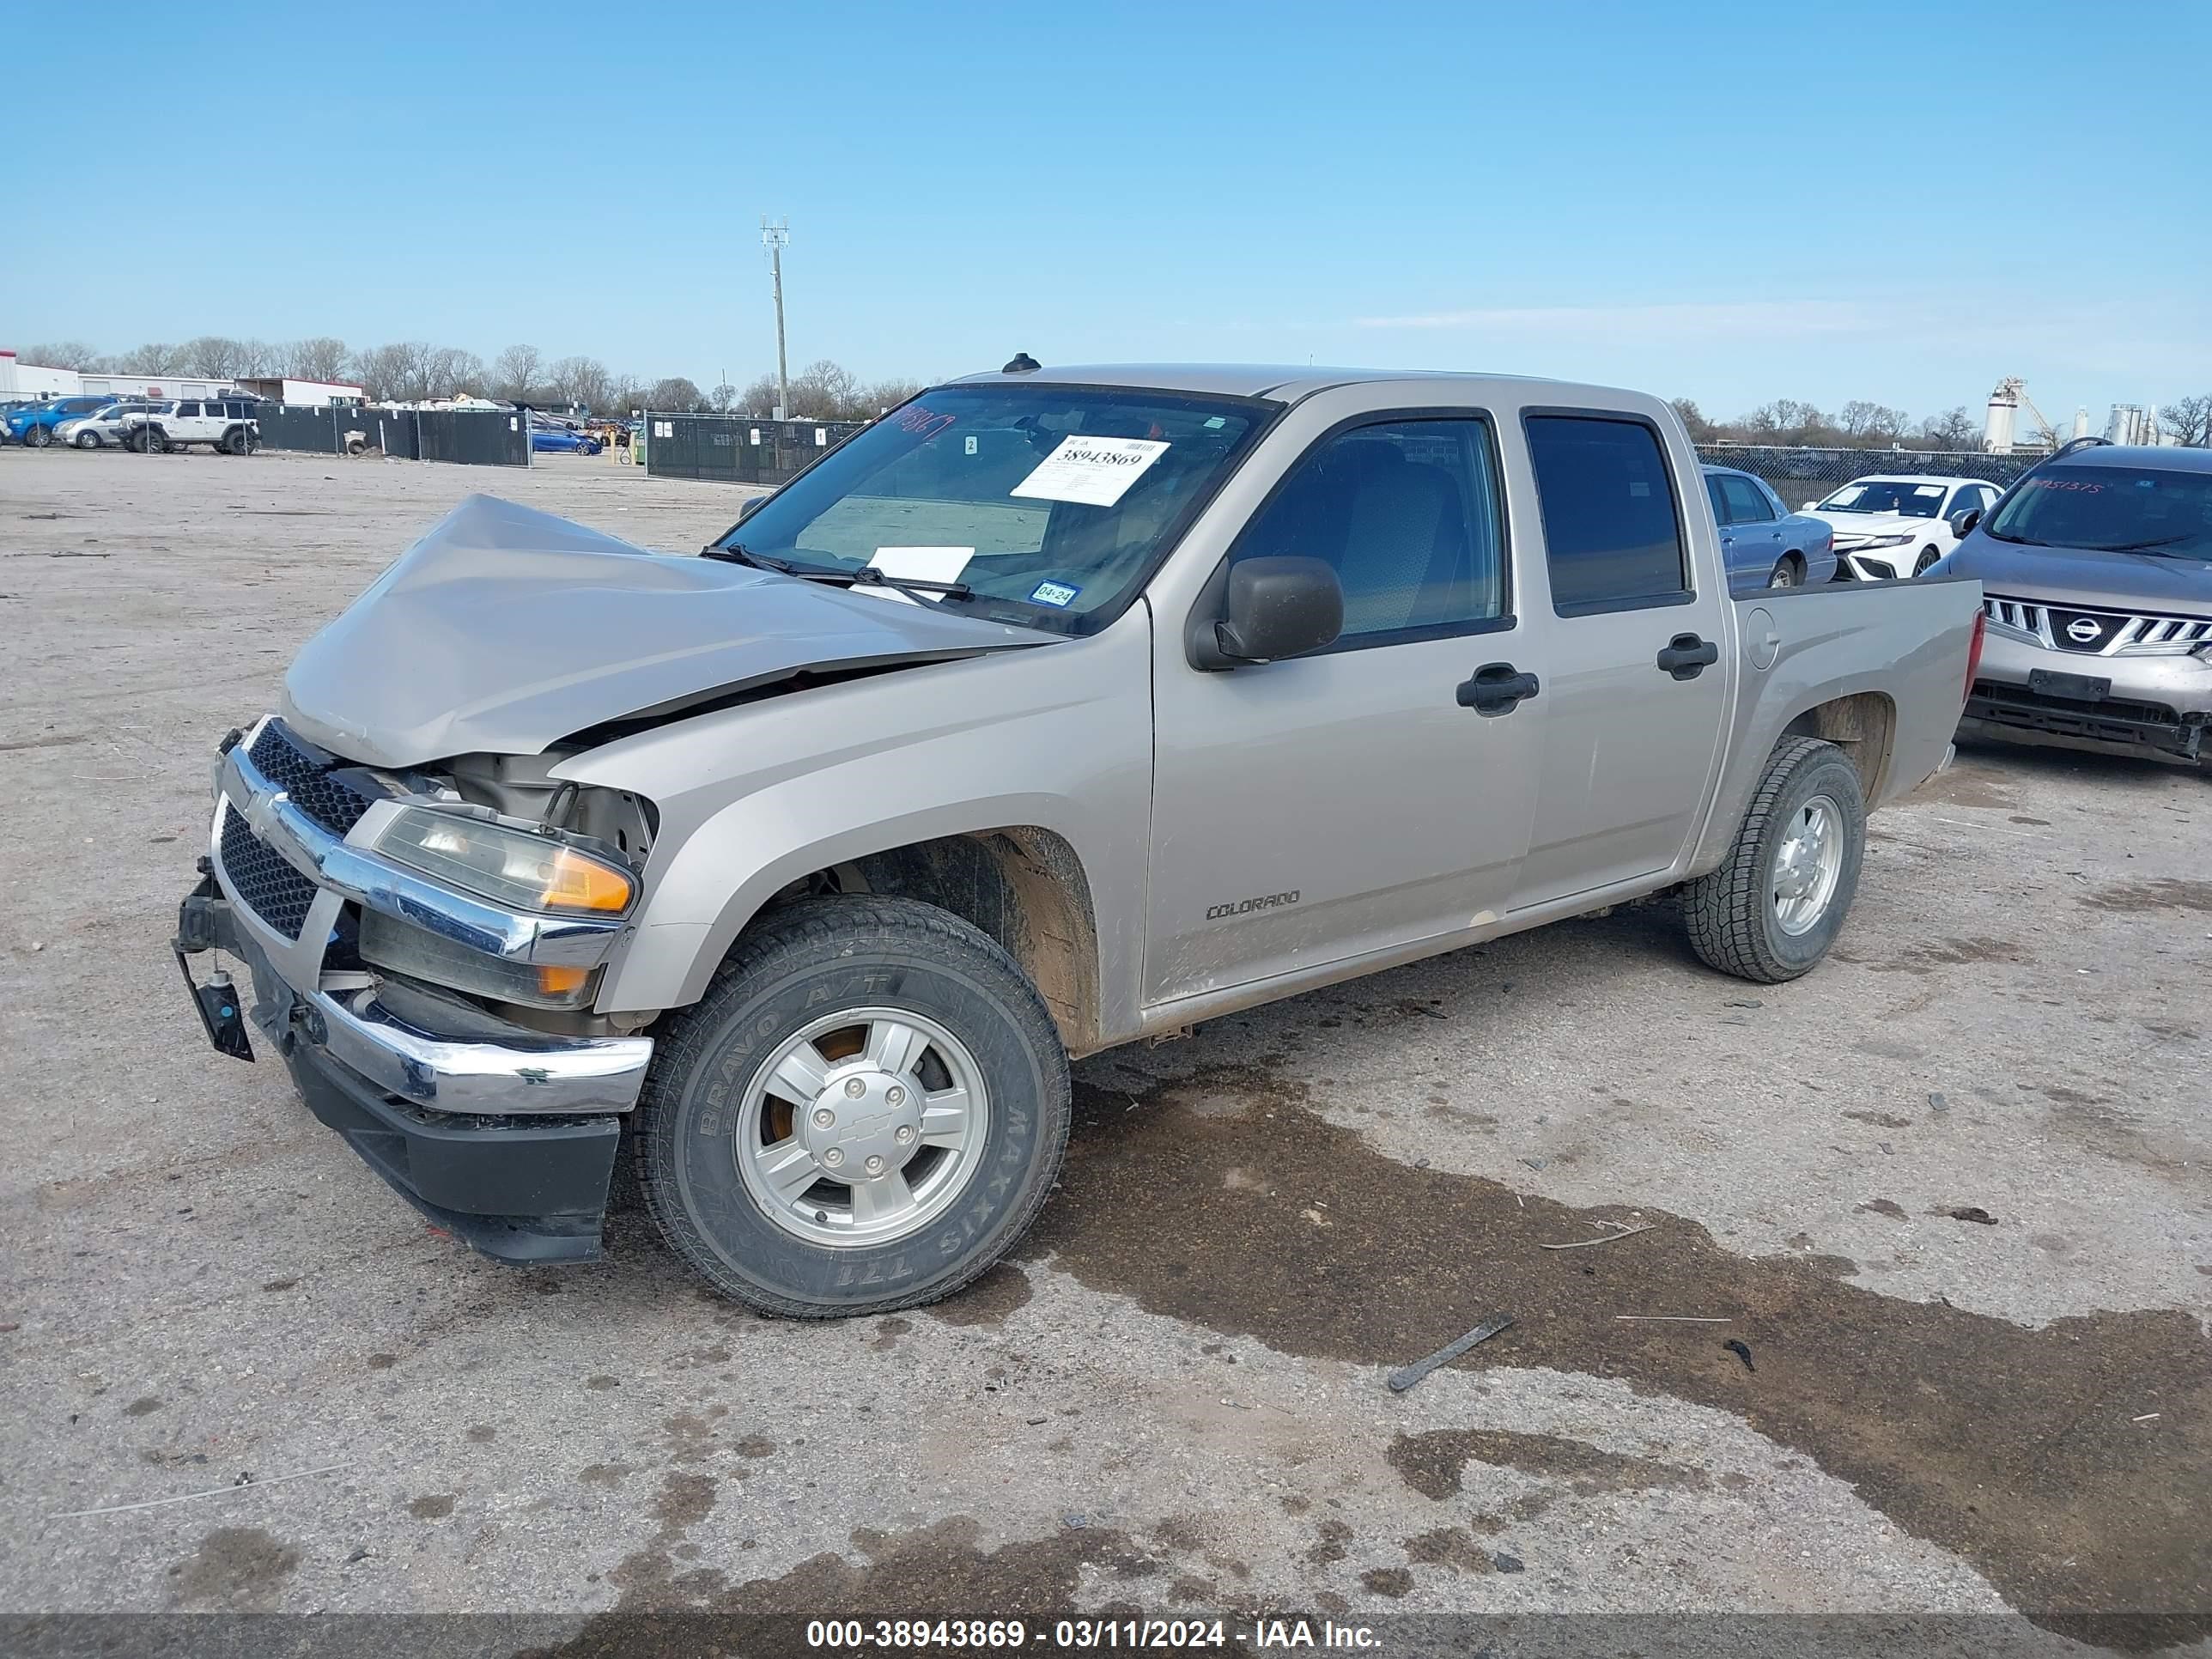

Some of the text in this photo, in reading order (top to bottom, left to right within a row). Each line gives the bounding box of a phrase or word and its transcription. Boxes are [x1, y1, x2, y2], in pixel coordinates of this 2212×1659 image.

[1056, 449, 1142, 466] 38943869
[1206, 890, 1301, 921] COLORADO
[699, 975, 890, 1138] BRAVO A/T
[939, 1105, 1029, 1255] MAXXIS
